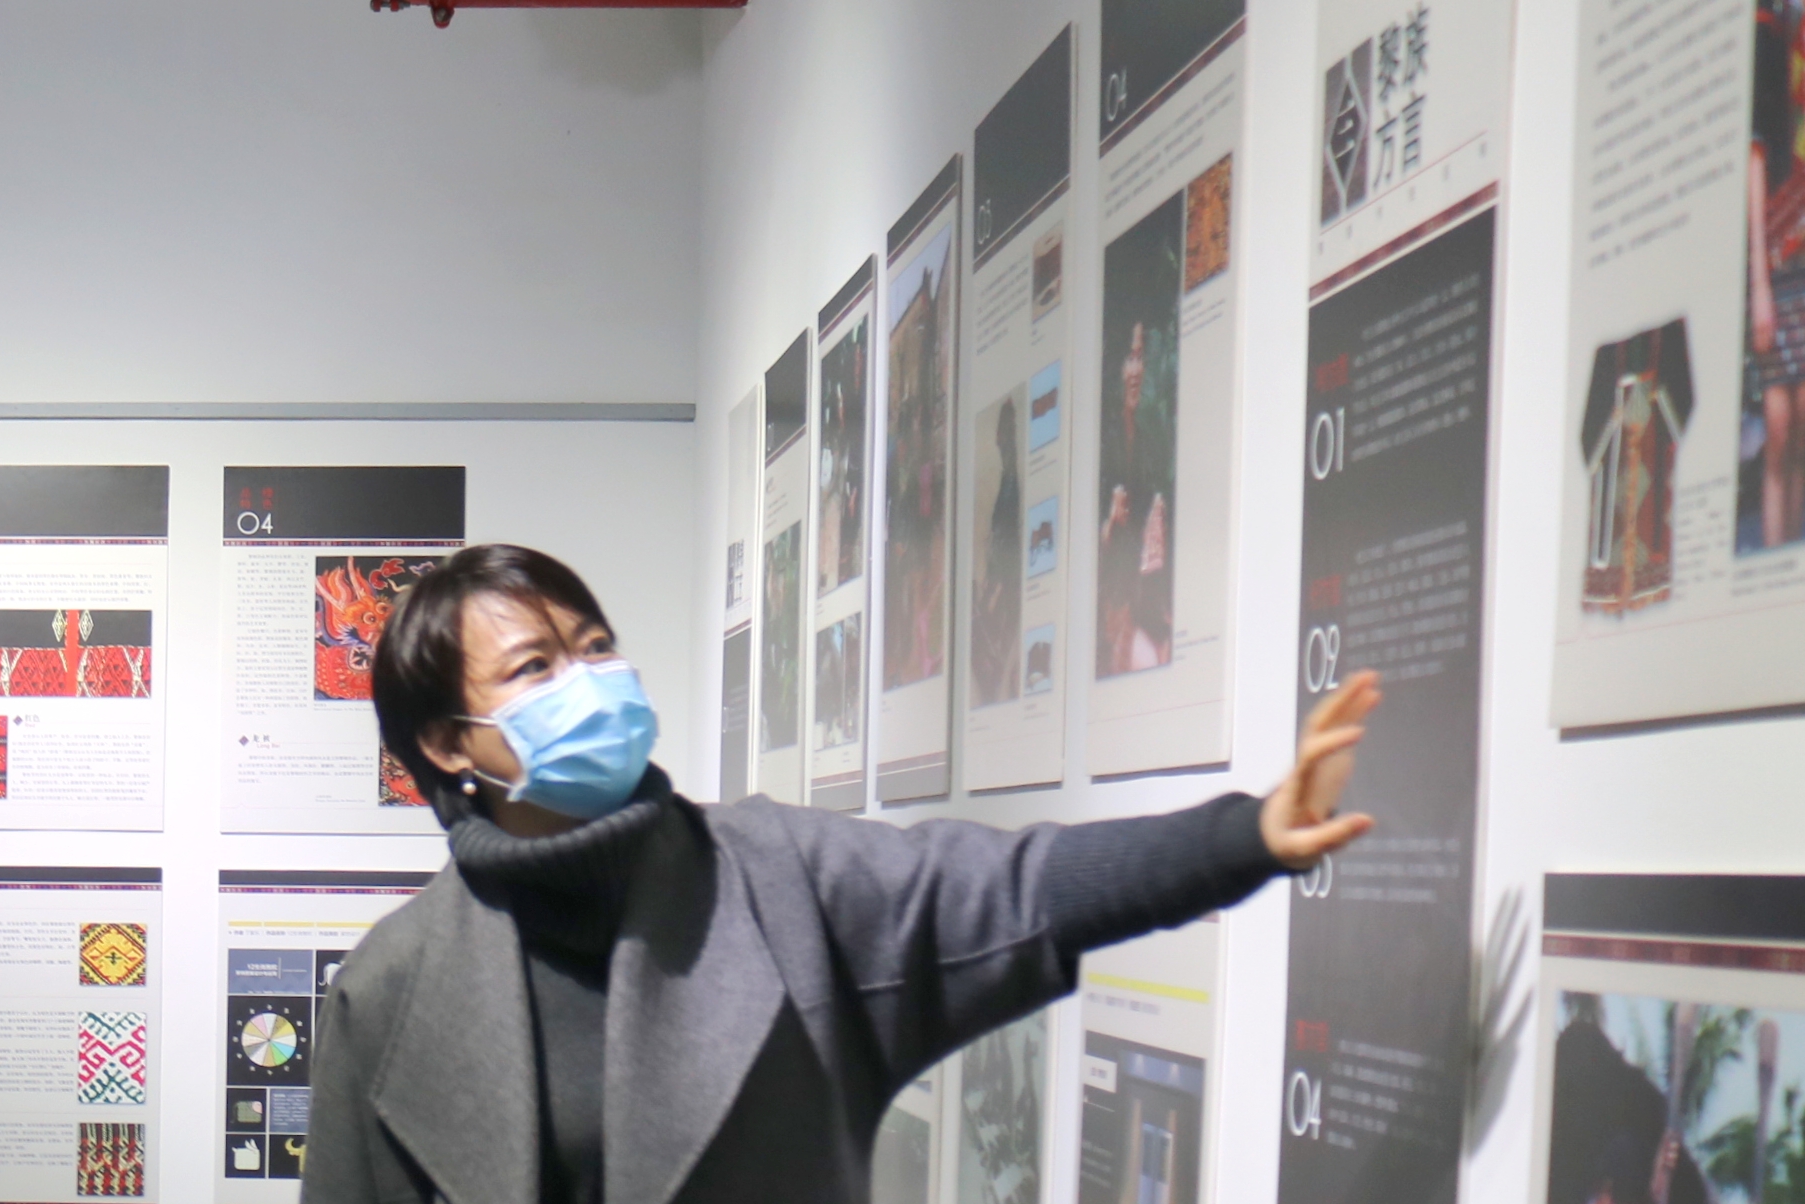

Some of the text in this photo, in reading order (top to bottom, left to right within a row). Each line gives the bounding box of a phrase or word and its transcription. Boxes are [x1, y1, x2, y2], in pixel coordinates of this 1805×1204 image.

[1377, 4, 1430, 103] 黎族
[1106, 68, 1128, 121] 04
[1372, 90, 1426, 190] 方言
[1309, 406, 1345, 480] 01
[237, 511, 274, 536] 04
[1306, 623, 1341, 693] 02
[1286, 1070, 1322, 1140] 04
